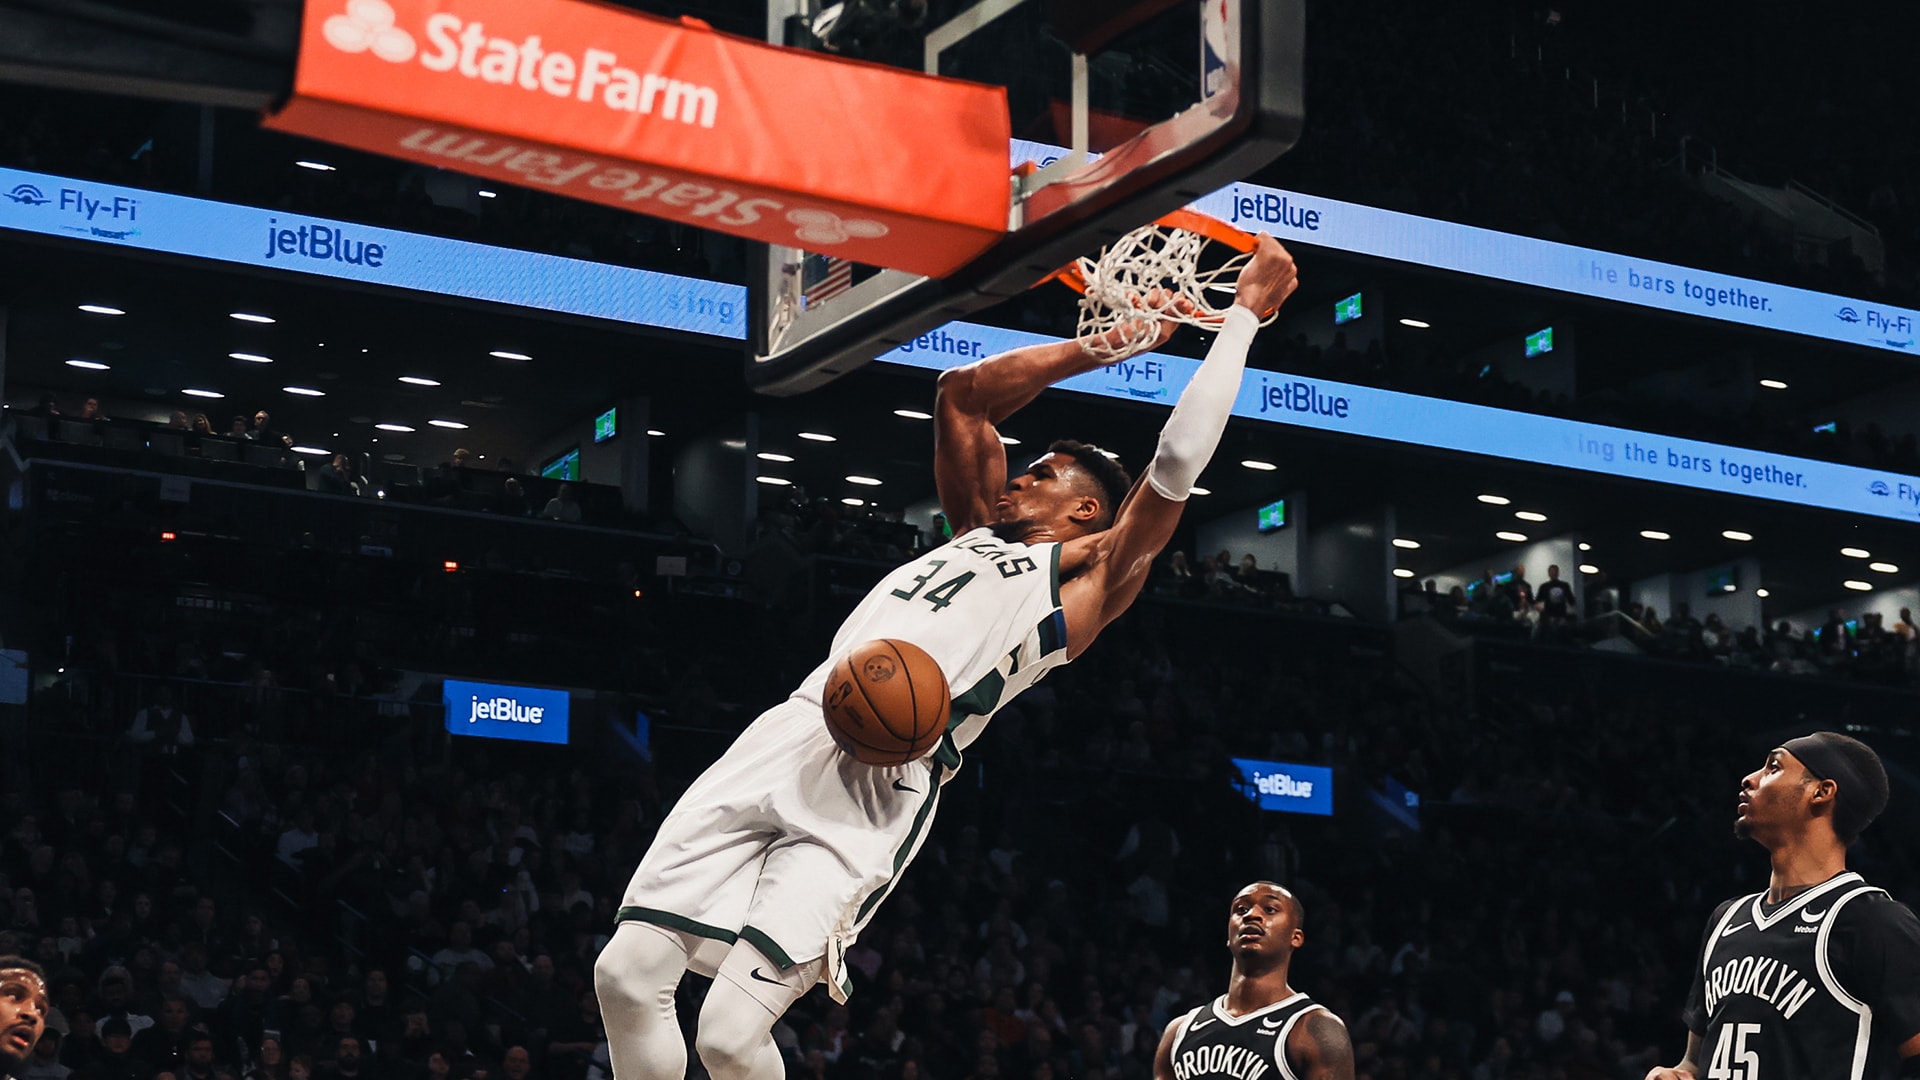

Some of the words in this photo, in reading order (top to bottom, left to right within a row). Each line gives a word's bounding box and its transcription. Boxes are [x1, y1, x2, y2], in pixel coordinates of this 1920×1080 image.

[60, 188, 137, 221] Fly-Fi
[1231, 188, 1320, 231] jetBlue
[265, 218, 385, 268] jetBlue
[1628, 267, 1675, 295] bars
[1684, 279, 1773, 313] together.
[1866, 310, 1911, 334] Fly-Fi
[900, 331, 986, 359] gether.
[1260, 377, 1349, 419] jetBlue
[1624, 442, 1658, 464] the
[1667, 448, 1712, 473] bars
[1720, 458, 1808, 488] together.
[891, 559, 977, 613] 34
[469, 695, 544, 724] jetBlue
[1705, 956, 1816, 1020] BROOKLYN
[1174, 1044, 1269, 1080] BROOKLYN
[1707, 1023, 1761, 1080] 45
